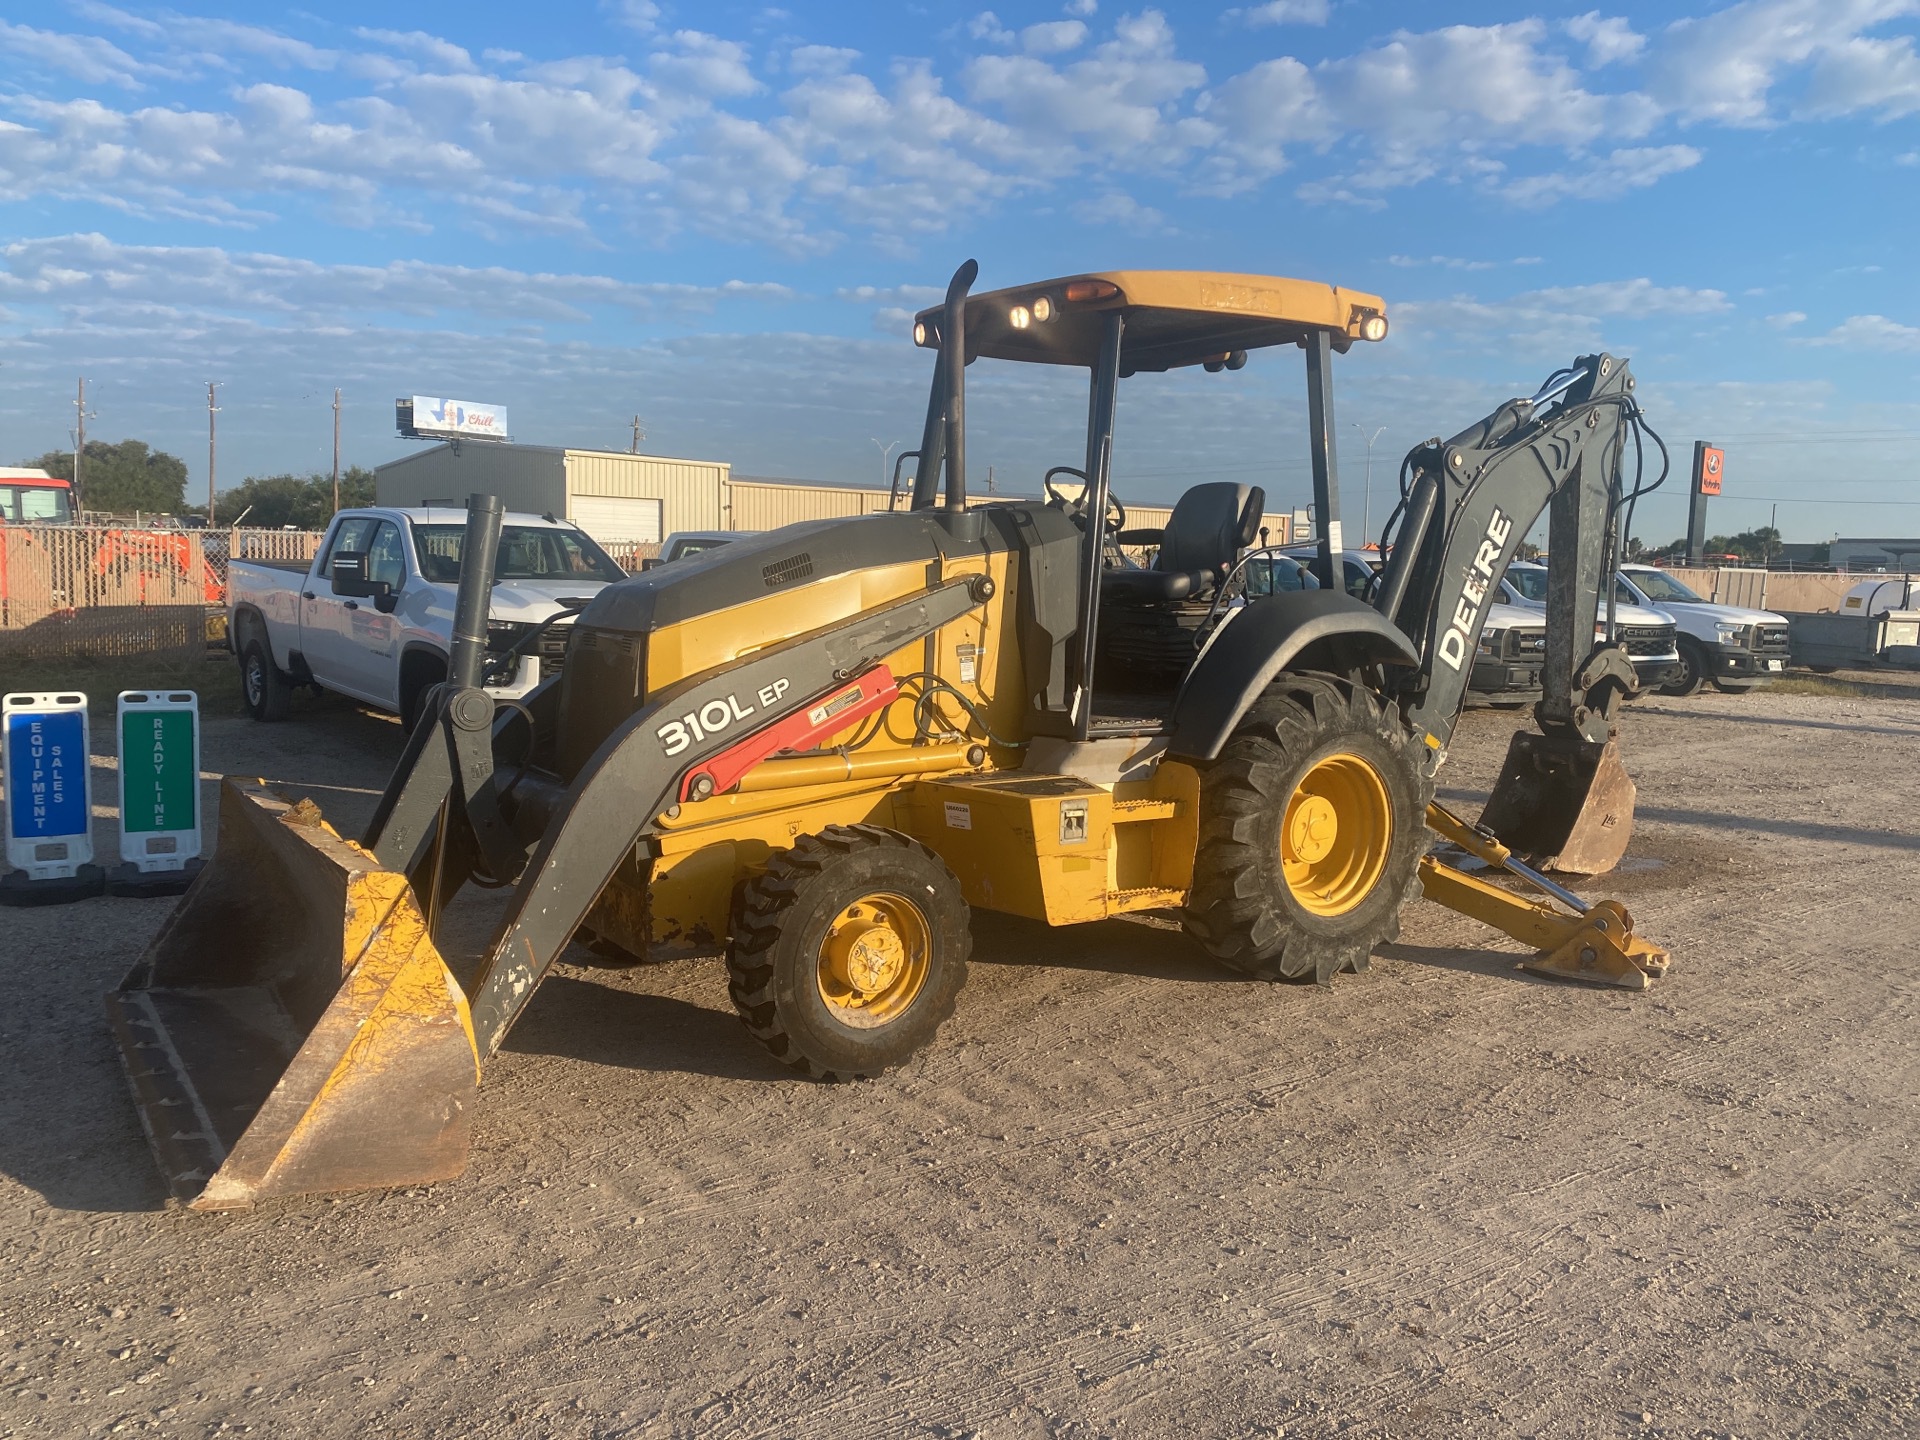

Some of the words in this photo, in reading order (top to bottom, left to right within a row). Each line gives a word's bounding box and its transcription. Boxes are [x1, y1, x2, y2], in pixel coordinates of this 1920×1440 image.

[468, 413, 495, 427] Chill
[1438, 508, 1512, 672] DEERE
[1627, 629, 1674, 637] CHEVR
[657, 694, 755, 756] 310L
[757, 677, 790, 708] EP
[31, 722, 46, 829] EQUIPMENT
[51, 745, 64, 804] SALES
[153, 718, 164, 775] READY
[154, 781, 164, 826] LINE
